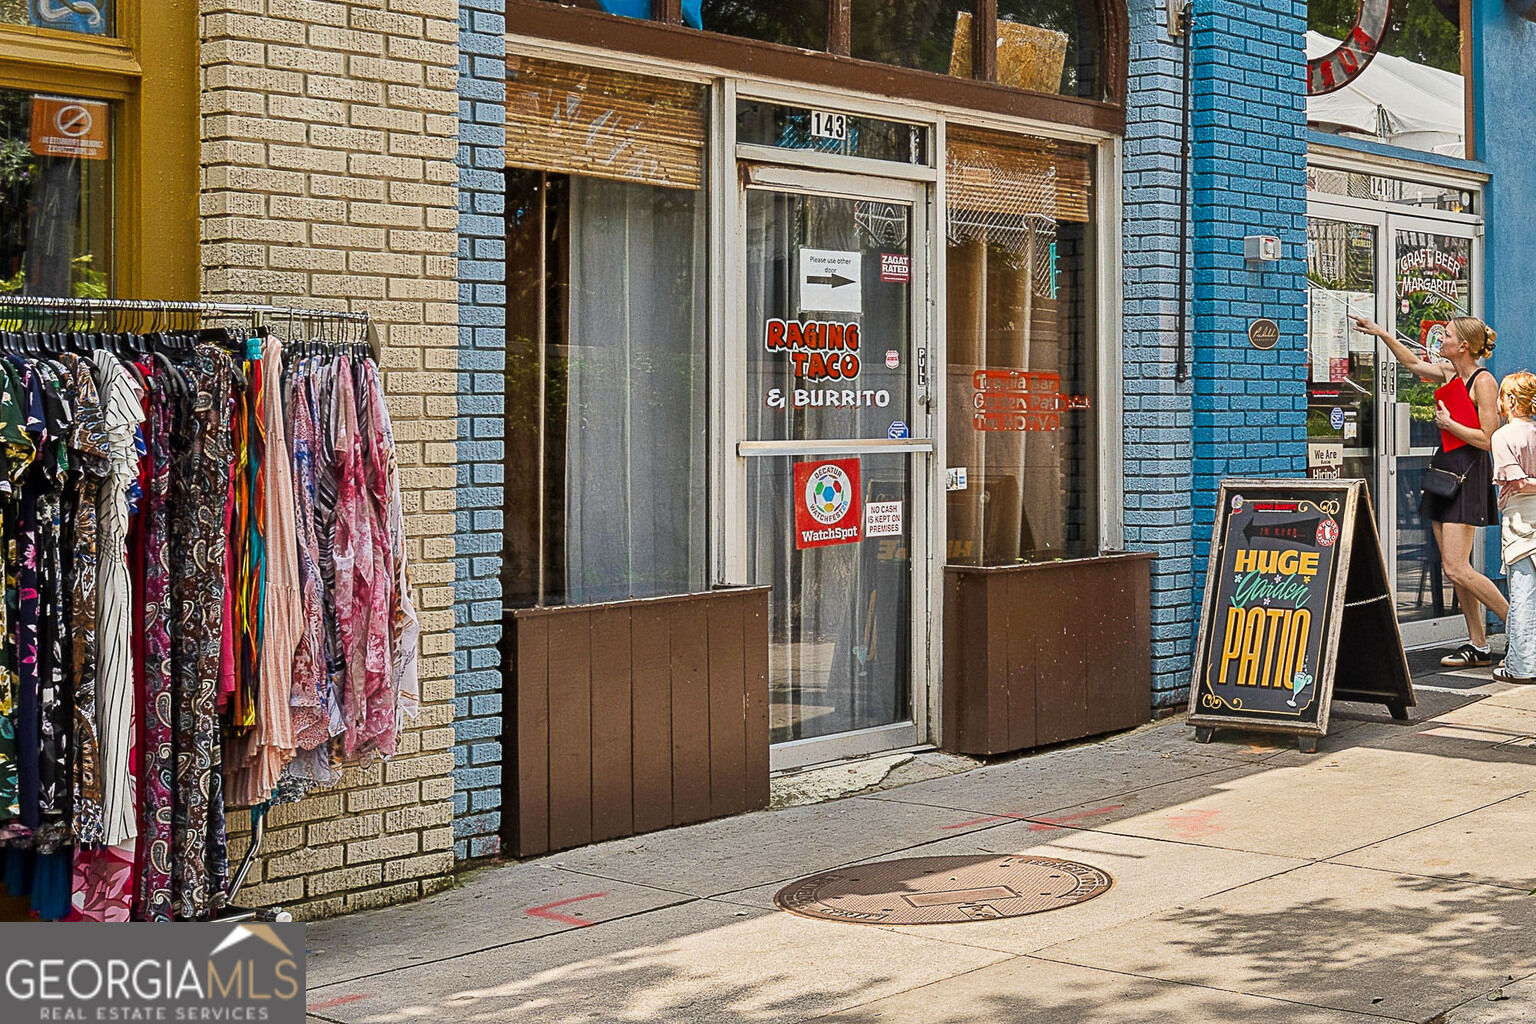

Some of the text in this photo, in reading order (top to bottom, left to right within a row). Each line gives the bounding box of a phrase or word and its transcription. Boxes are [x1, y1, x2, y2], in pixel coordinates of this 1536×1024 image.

[814, 112, 845, 138] 143
[1372, 177, 1388, 196] 141
[809, 255, 826, 264] Please
[837, 257, 852, 265] other
[824, 266, 837, 274] door
[881, 255, 909, 265] ZAGAT
[881, 263, 909, 274] RATED
[1400, 249, 1460, 279] CRAFT BEER
[1400, 276, 1459, 300] MARGARITA
[766, 319, 861, 351] RAGING
[791, 352, 861, 382] TACO
[918, 348, 926, 385] PULL
[766, 388, 890, 409] & BURRITO
[1314, 449, 1337, 459] We Are
[814, 466, 842, 479] DECATUR
[871, 505, 897, 514] NO CASH
[802, 526, 858, 543] WatchSpot
[869, 525, 899, 533] PREMISES
[1234, 549, 1320, 576] HUGE
[1230, 568, 1312, 609] Garden
[1218, 606, 1312, 690] PATIO
